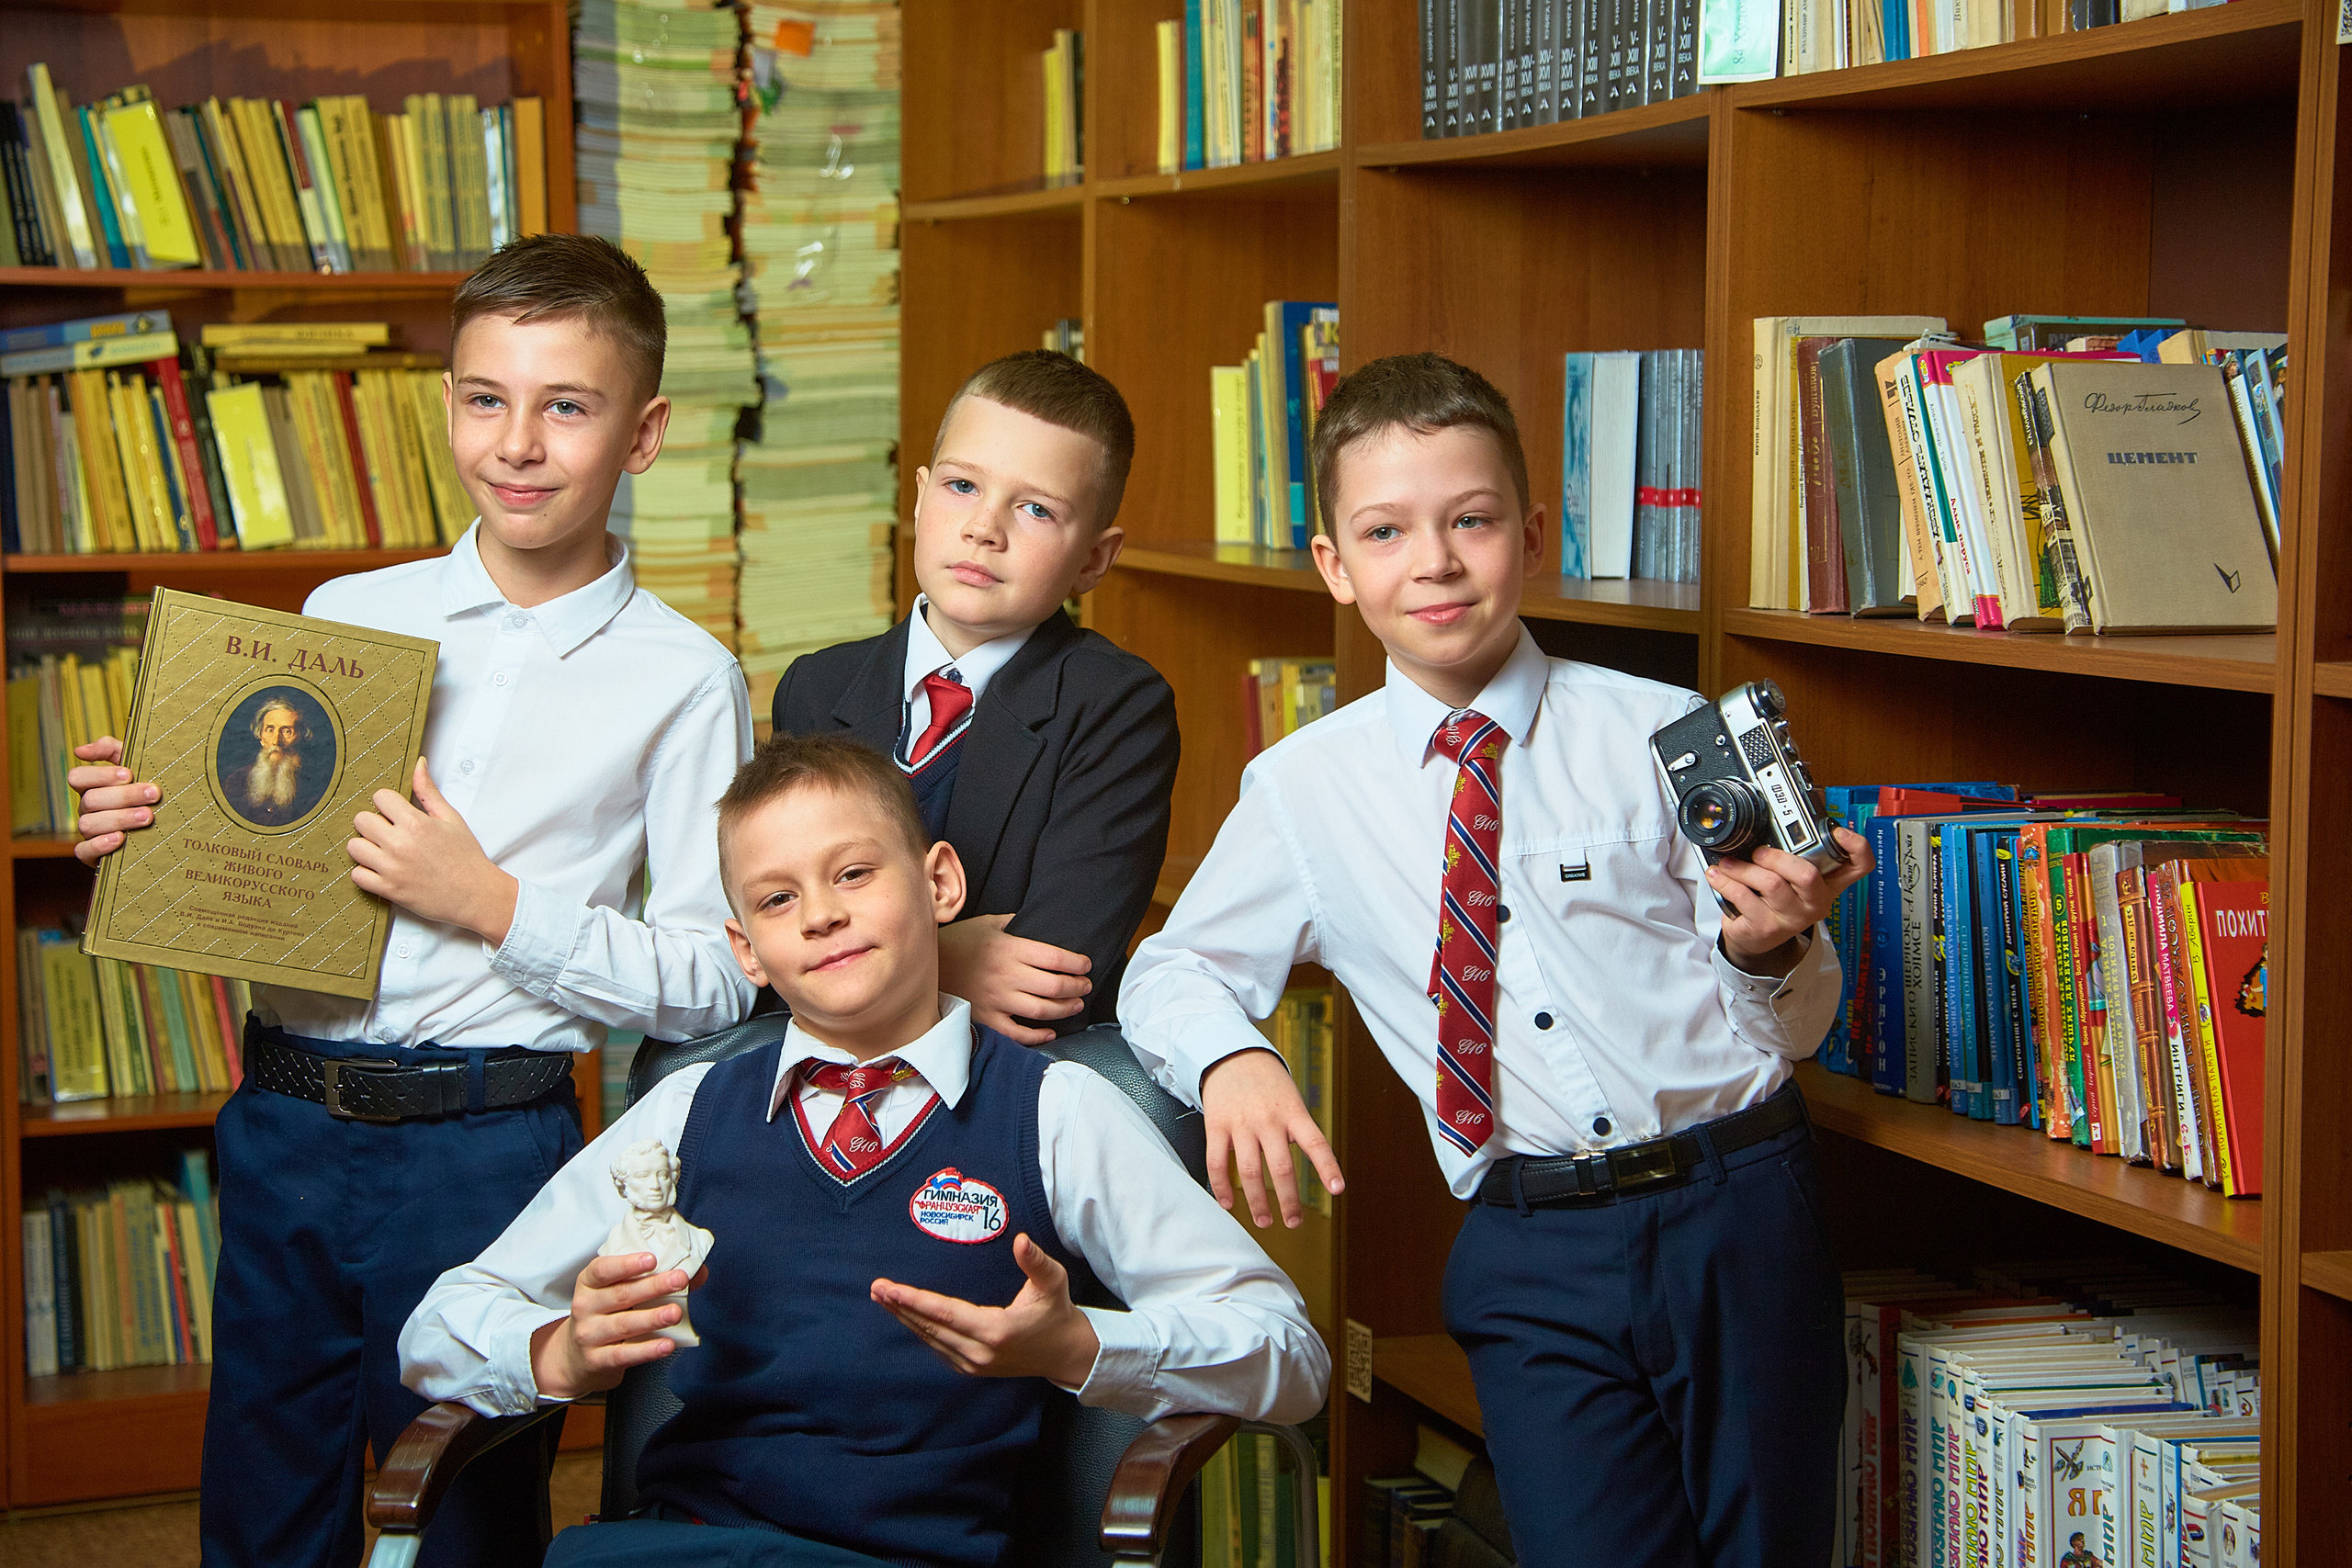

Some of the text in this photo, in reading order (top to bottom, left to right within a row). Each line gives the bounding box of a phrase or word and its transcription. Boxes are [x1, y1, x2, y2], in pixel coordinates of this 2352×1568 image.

[1678, 51, 1692, 64] ВЕКА
[1679, 33, 1692, 51] XIII
[1734, 49, 1746, 64] 84
[1625, 65, 1640, 77] ВЕКА
[1653, 61, 1666, 73] ВЕКА
[1753, 389, 1761, 430] БОНДАРЕВ
[1810, 365, 1819, 418] Булгаков
[1965, 381, 1979, 435] РАССК
[2084, 392, 2201, 426] Федор Гладков
[2232, 380, 2245, 423] ЧЕЛОВЕК
[1789, 400, 1798, 490] ЮРИЙ БОНДАРЕВ
[1894, 415, 1905, 457] АНАТОЛИЙ
[1929, 402, 1949, 473] Александр Грин
[1900, 374, 1939, 539] ДВЕНАДЦАТЬ СТУЛЬЕВ
[2107, 451, 2199, 467] ЦЕМЕНТ
[1911, 496, 1922, 536] ВРЕМЕНЕМ
[1916, 536, 1924, 554] ТЕМ
[1950, 497, 1972, 576] Алые паруса
[225, 635, 365, 680] В.И. ДАЛЬ
[1473, 814, 1500, 832] G16
[182, 838, 330, 874] ТОЛКОВЫЙ СЛОВАРЬ
[223, 860, 283, 880] ЖИВОГО
[1875, 829, 1885, 915] Кристофер Паолини
[1902, 833, 1921, 912] А. Конан Дойл
[2017, 856, 2027, 888] БЫВАЕТ
[2064, 866, 2072, 875] же
[185, 869, 315, 900] ВЕЛИКОРУССКОГО
[222, 891, 273, 908] ЯЗЫКА
[1466, 889, 1498, 908] G16
[1998, 863, 2013, 945] ДМИТРИЙ СУСЛИН
[2019, 890, 2027, 902] НЕ
[2055, 898, 2063, 911] 5
[2065, 877, 2075, 897] такие
[179, 910, 195, 919] В.И.
[196, 914, 213, 923] Даля
[221, 917, 236, 926] И.А.
[238, 920, 266, 931] Бодуэна
[277, 928, 305, 938] Куртенэ
[188, 905, 299, 929] Совмещенная редакция изданий
[2020, 903, 2030, 942] КАНИКУЛ
[2067, 899, 2078, 923] другие
[203, 923, 248, 935] современном
[250, 931, 285, 942] написании
[1901, 912, 1913, 988] ШЕРЛОКЕ
[1945, 923, 1955, 973] КОЛДУНЬЯ
[2070, 931, 2081, 957] Белкин
[2124, 907, 2138, 982] Битва за Лес
[2154, 883, 2174, 1012] ЛЮДМИЛА МАТВЕЕВА
[2165, 903, 2186, 990] УЖАСОВ
[2185, 902, 2200, 964] В. Аверин
[1462, 964, 1491, 982] G16
[1909, 919, 1922, 988] ХОЛМСЕ
[2074, 959, 2083, 976] Вася
[1949, 975, 1955, 983] И
[1960, 924, 1973, 1050] СЕРЕБРЯНОЕ КРЕСЛО
[1981, 925, 1998, 1063] КОНЬ И ЕГО МАЛЬЧИК
[2009, 983, 2018, 1008] НЕБА
[2023, 943, 2037, 1010] СЫЩИКОВ
[2054, 920, 2072, 1062] БОЛЬШАЯ КНИГА
[2060, 919, 2077, 1062] ЛУЧШИХ ДЕТЕКТИВОВ
[1948, 985, 1959, 1037] ПЛАТЯНОЙ
[2075, 977, 2088, 1022] Абрамушкин,
[2100, 938, 2122, 1079] БОЛЬШАЯ КНИГА
[2108, 935, 2128, 1079] ЛУЧШИХ ДЕТЕКТИВОВ
[1905, 990, 1920, 1084] ЗАПИСКИ О
[2080, 1025, 2089, 1045] Вовка
[2177, 990, 2194, 1057] КНИГА
[1457, 1038, 1487, 1055] G16
[1933, 1027, 1941, 1066] ПЯТНИЦА
[1951, 1039, 1960, 1068] ШКАФ
[2012, 1021, 2024, 1079] СОКРОВИЩЕ
[2088, 1090, 2099, 1118] Сергей
[2170, 1043, 2193, 1166] ИНТРИГИ в 6 «Б»
[2204, 1038, 2225, 1151] ПОХИТИТЕЛЬ ПАМЯТИ
[1455, 1110, 1485, 1125] G16
[849, 1135, 878, 1153] G16
[915, 1201, 984, 1215] "ФРАНЦУЗСКАЯ"
[920, 1211, 975, 1223] НОВОСИБИРСК
[923, 1189, 999, 1209] ГИМНАЗИЯ
[982, 1205, 1001, 1232] 16
[920, 1217, 949, 1226] РОССИЯ
[1904, 1408, 1918, 1466] МИР
[1931, 1416, 1946, 1474] МИР
[1948, 1423, 1961, 1486] МИР
[1964, 1438, 1977, 1498] МИР
[1977, 1463, 1990, 1525] МИР
[1994, 1477, 2005, 1540] МИР
[2067, 1488, 2087, 1517] Я
[2024, 1501, 2037, 1564] МИР
[2102, 1503, 2116, 1567] МИР
[2140, 1499, 2156, 1568] МИР
